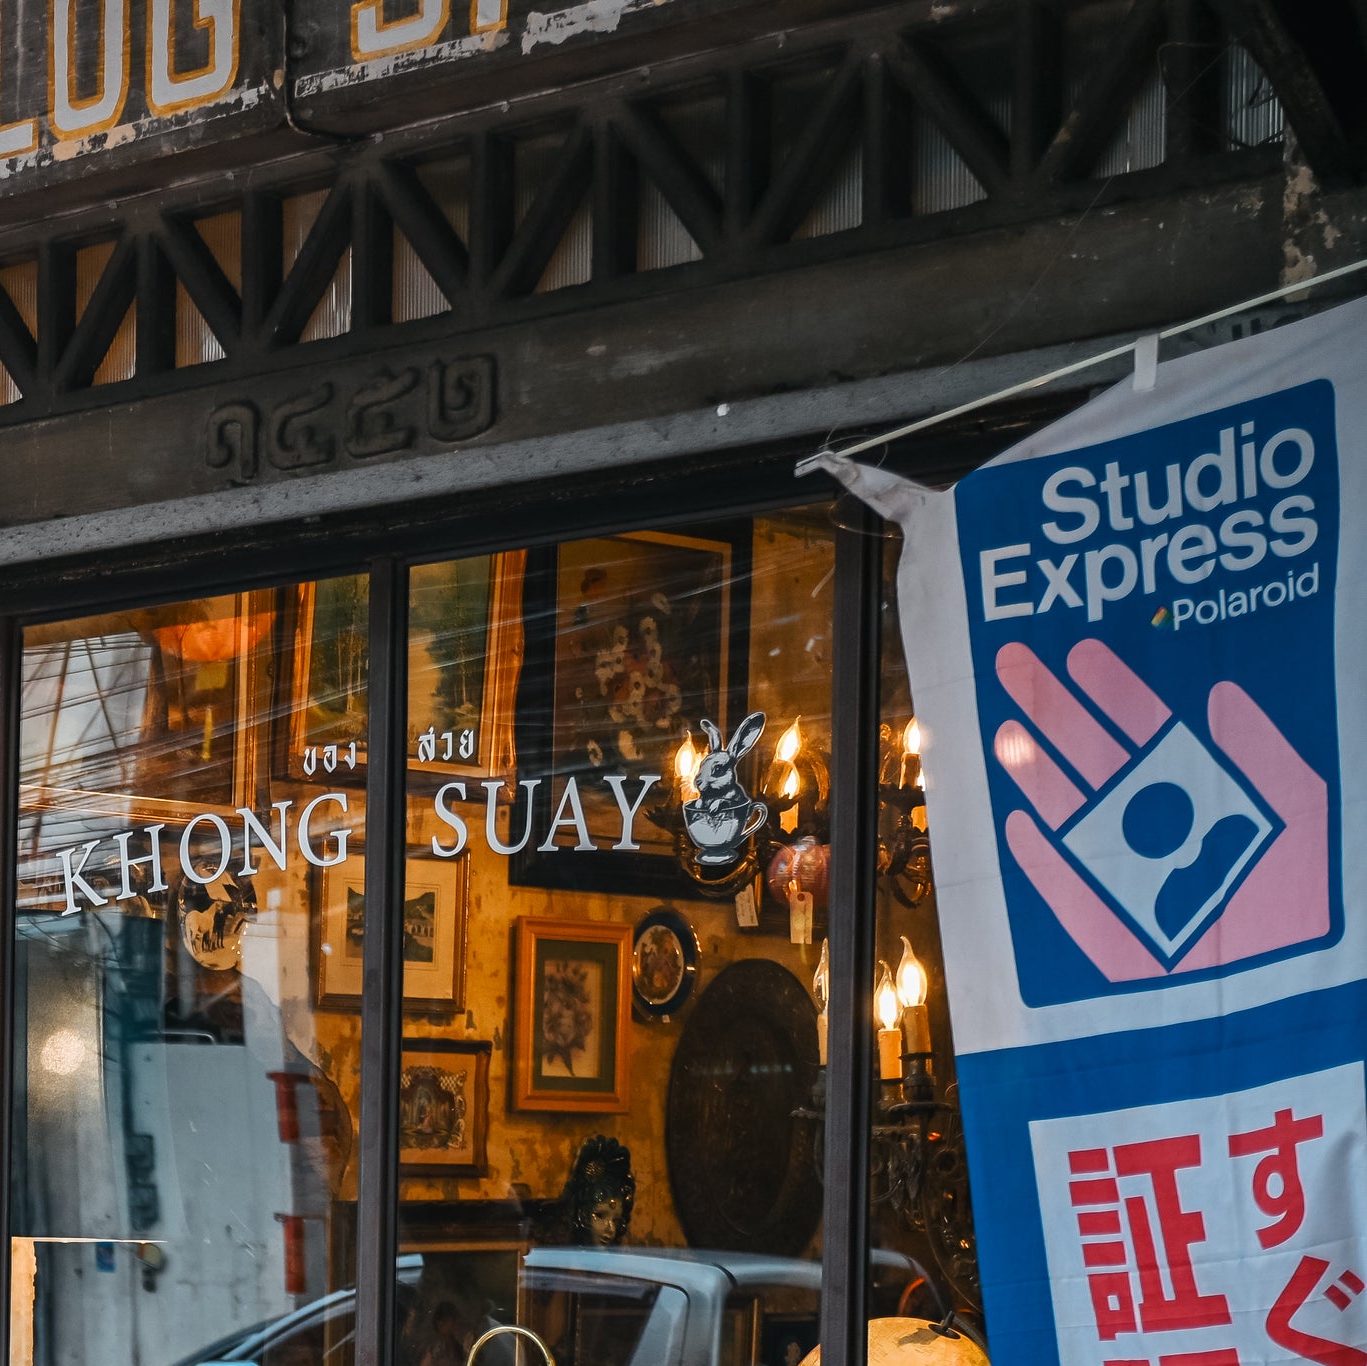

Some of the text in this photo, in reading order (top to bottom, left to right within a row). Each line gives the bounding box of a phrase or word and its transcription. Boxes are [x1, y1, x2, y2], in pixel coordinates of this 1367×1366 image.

[1041, 420, 1315, 545] Studio
[979, 495, 1319, 624] Express
[1173, 562, 1320, 633] Polaroid
[303, 741, 357, 777] ของ
[56, 774, 663, 917] KHONG SUAY
